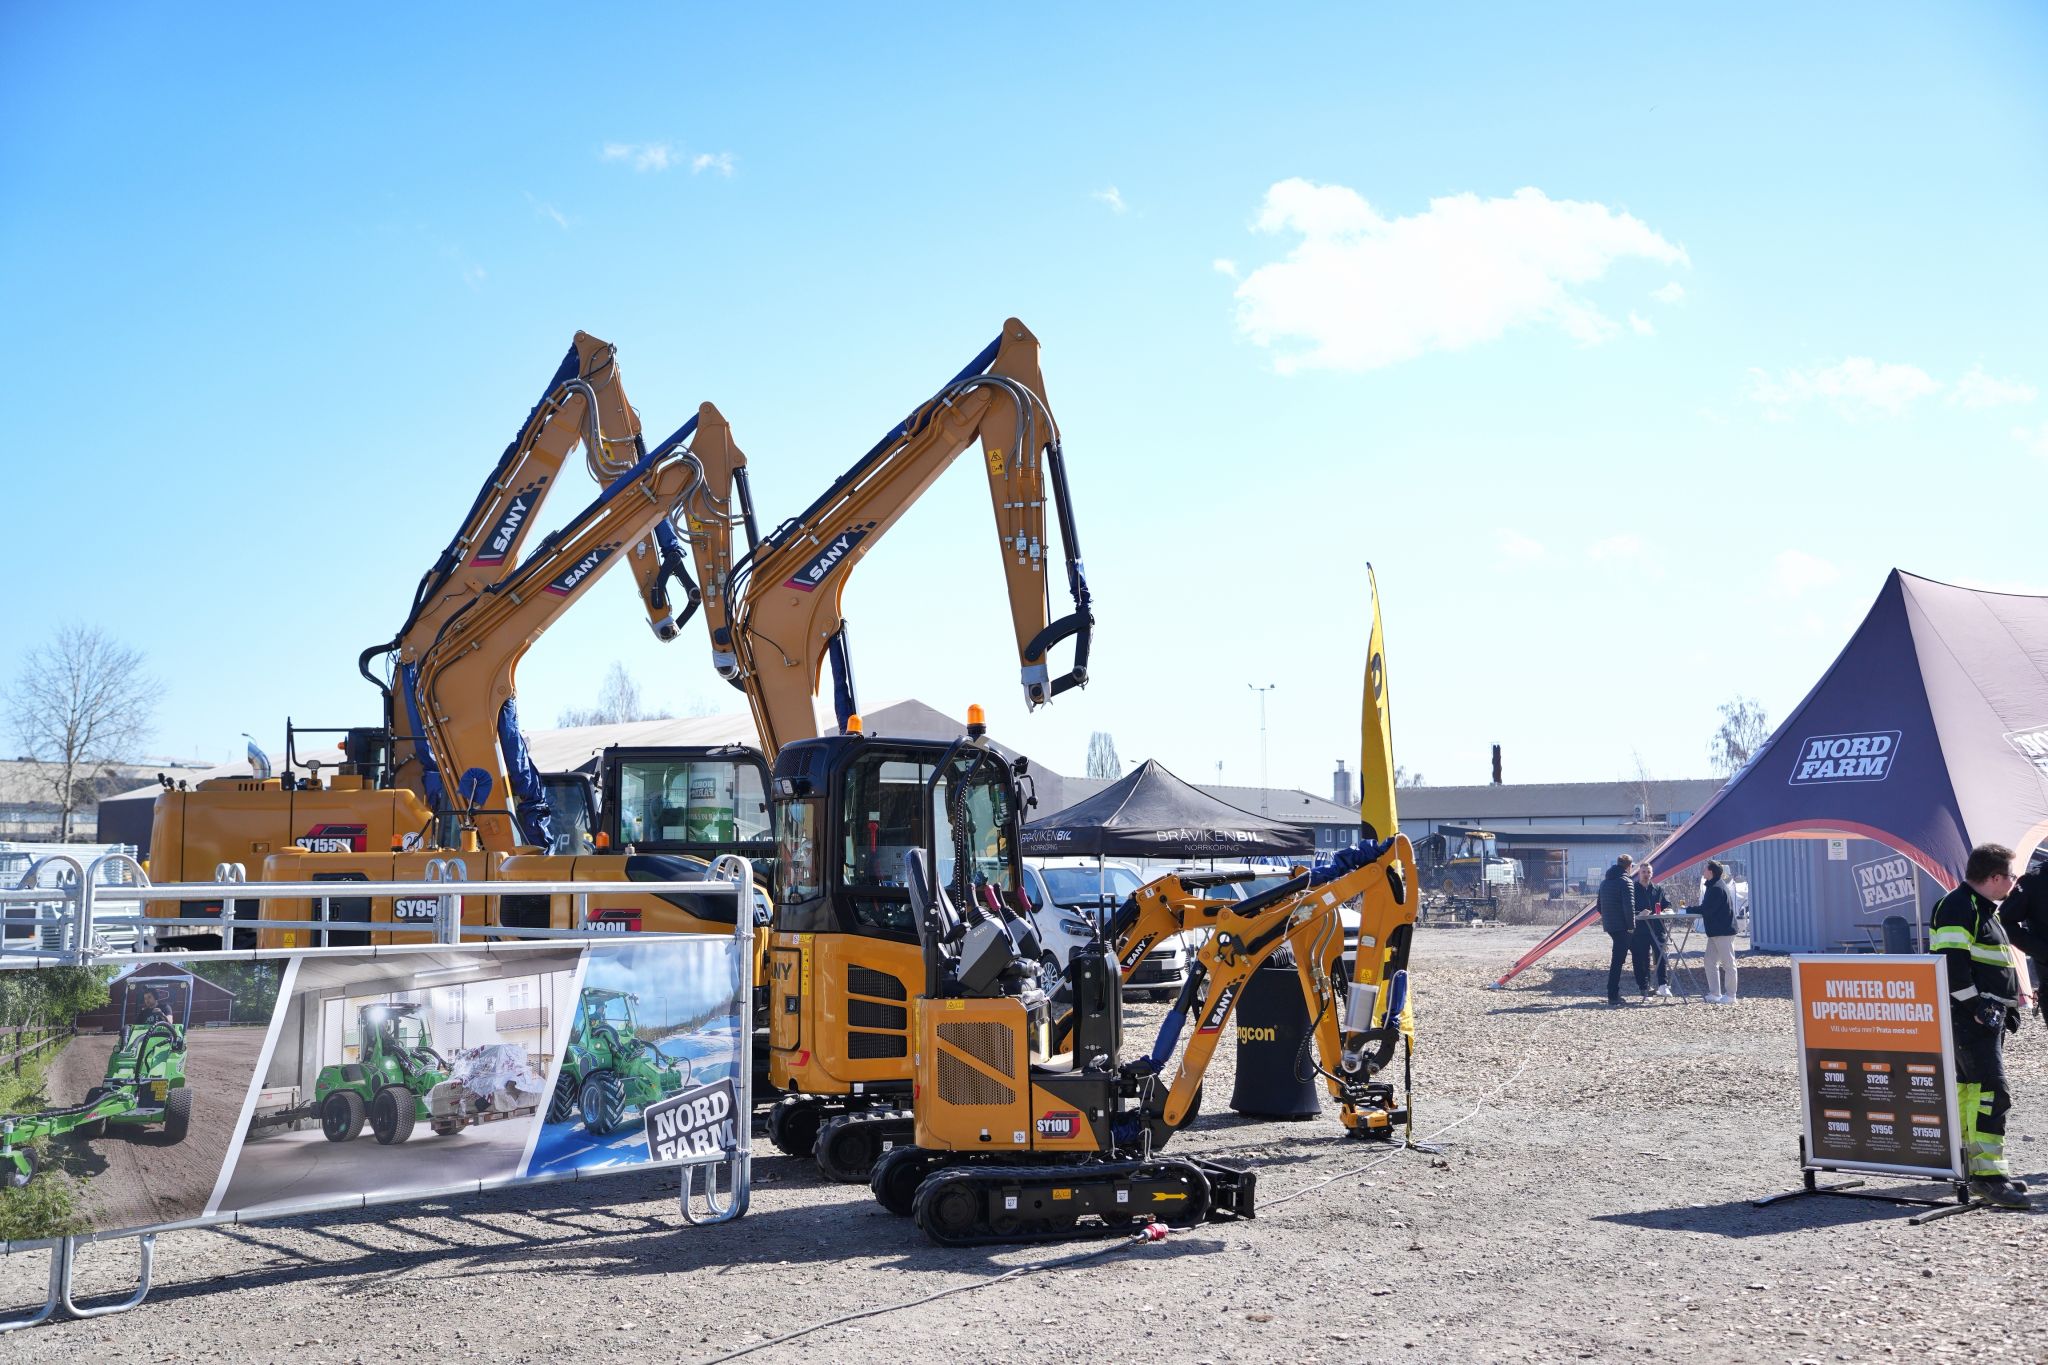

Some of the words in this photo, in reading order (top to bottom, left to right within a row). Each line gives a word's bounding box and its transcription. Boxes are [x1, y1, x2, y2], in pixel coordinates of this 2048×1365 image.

[492, 497, 528, 553] SANY
[809, 535, 850, 581] SANY
[564, 551, 600, 588] SANY
[1806, 736, 1891, 759] NORD
[1796, 757, 1888, 780] FARM
[1157, 828, 1264, 842] BRÅVIKENBIL
[1859, 859, 1908, 887] NORD
[1862, 878, 1916, 907] FARM
[396, 900, 440, 917] SY95
[1126, 940, 1147, 966] SANY
[771, 962, 793, 980] NY
[1825, 980, 1884, 999] NYHETER
[1886, 981, 1916, 999] OCH
[1211, 988, 1234, 1025] SANY
[1812, 1001, 1935, 1022] UPPGRADERINGAR
[1236, 1026, 1276, 1045] ngcon
[1824, 1072, 1845, 1082] SY10U
[1866, 1074, 1889, 1084] SY20C
[1911, 1076, 1933, 1086] SY75C
[654, 1091, 730, 1142] NORD
[1036, 1119, 1070, 1132] SY10U
[1827, 1121, 1850, 1132] SY80U
[657, 1118, 737, 1160] FARM
[1870, 1124, 1893, 1134] SY95C
[1912, 1126, 1941, 1138] SY155W
